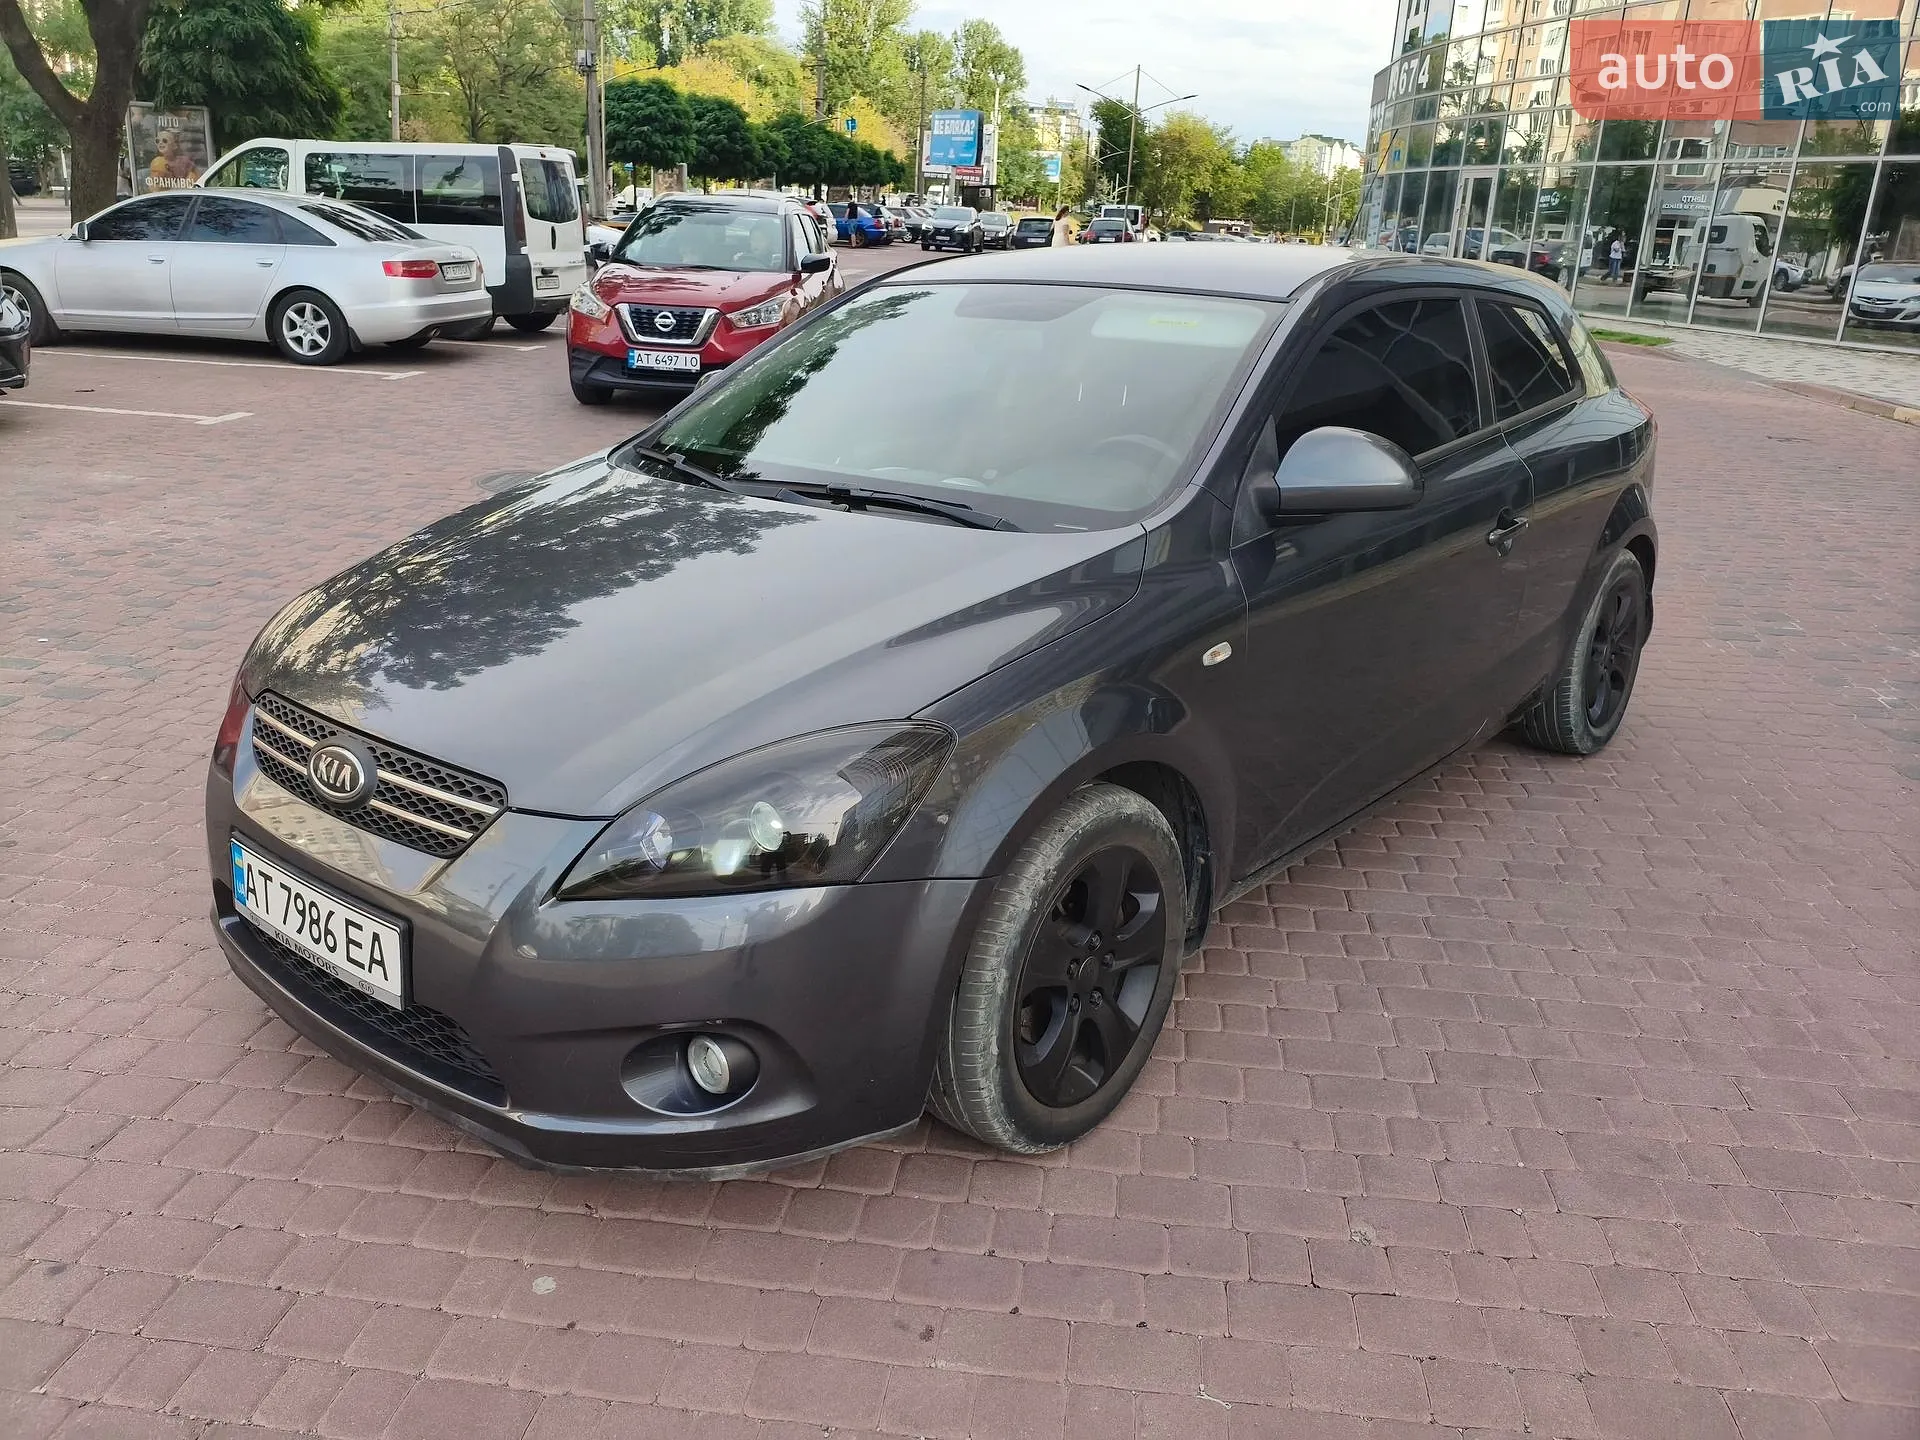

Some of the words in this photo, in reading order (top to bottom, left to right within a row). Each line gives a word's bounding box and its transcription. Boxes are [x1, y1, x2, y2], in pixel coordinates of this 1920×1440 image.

[158, 115, 179, 128] ЛІТО
[636, 353, 651, 364] AT
[655, 354, 678, 366] 6497
[317, 754, 352, 791] KIA
[246, 863, 273, 915] AT
[279, 881, 338, 954] 7986
[345, 917, 389, 982] EA
[273, 930, 292, 949] KIA
[294, 943, 339, 977] MOTORS
